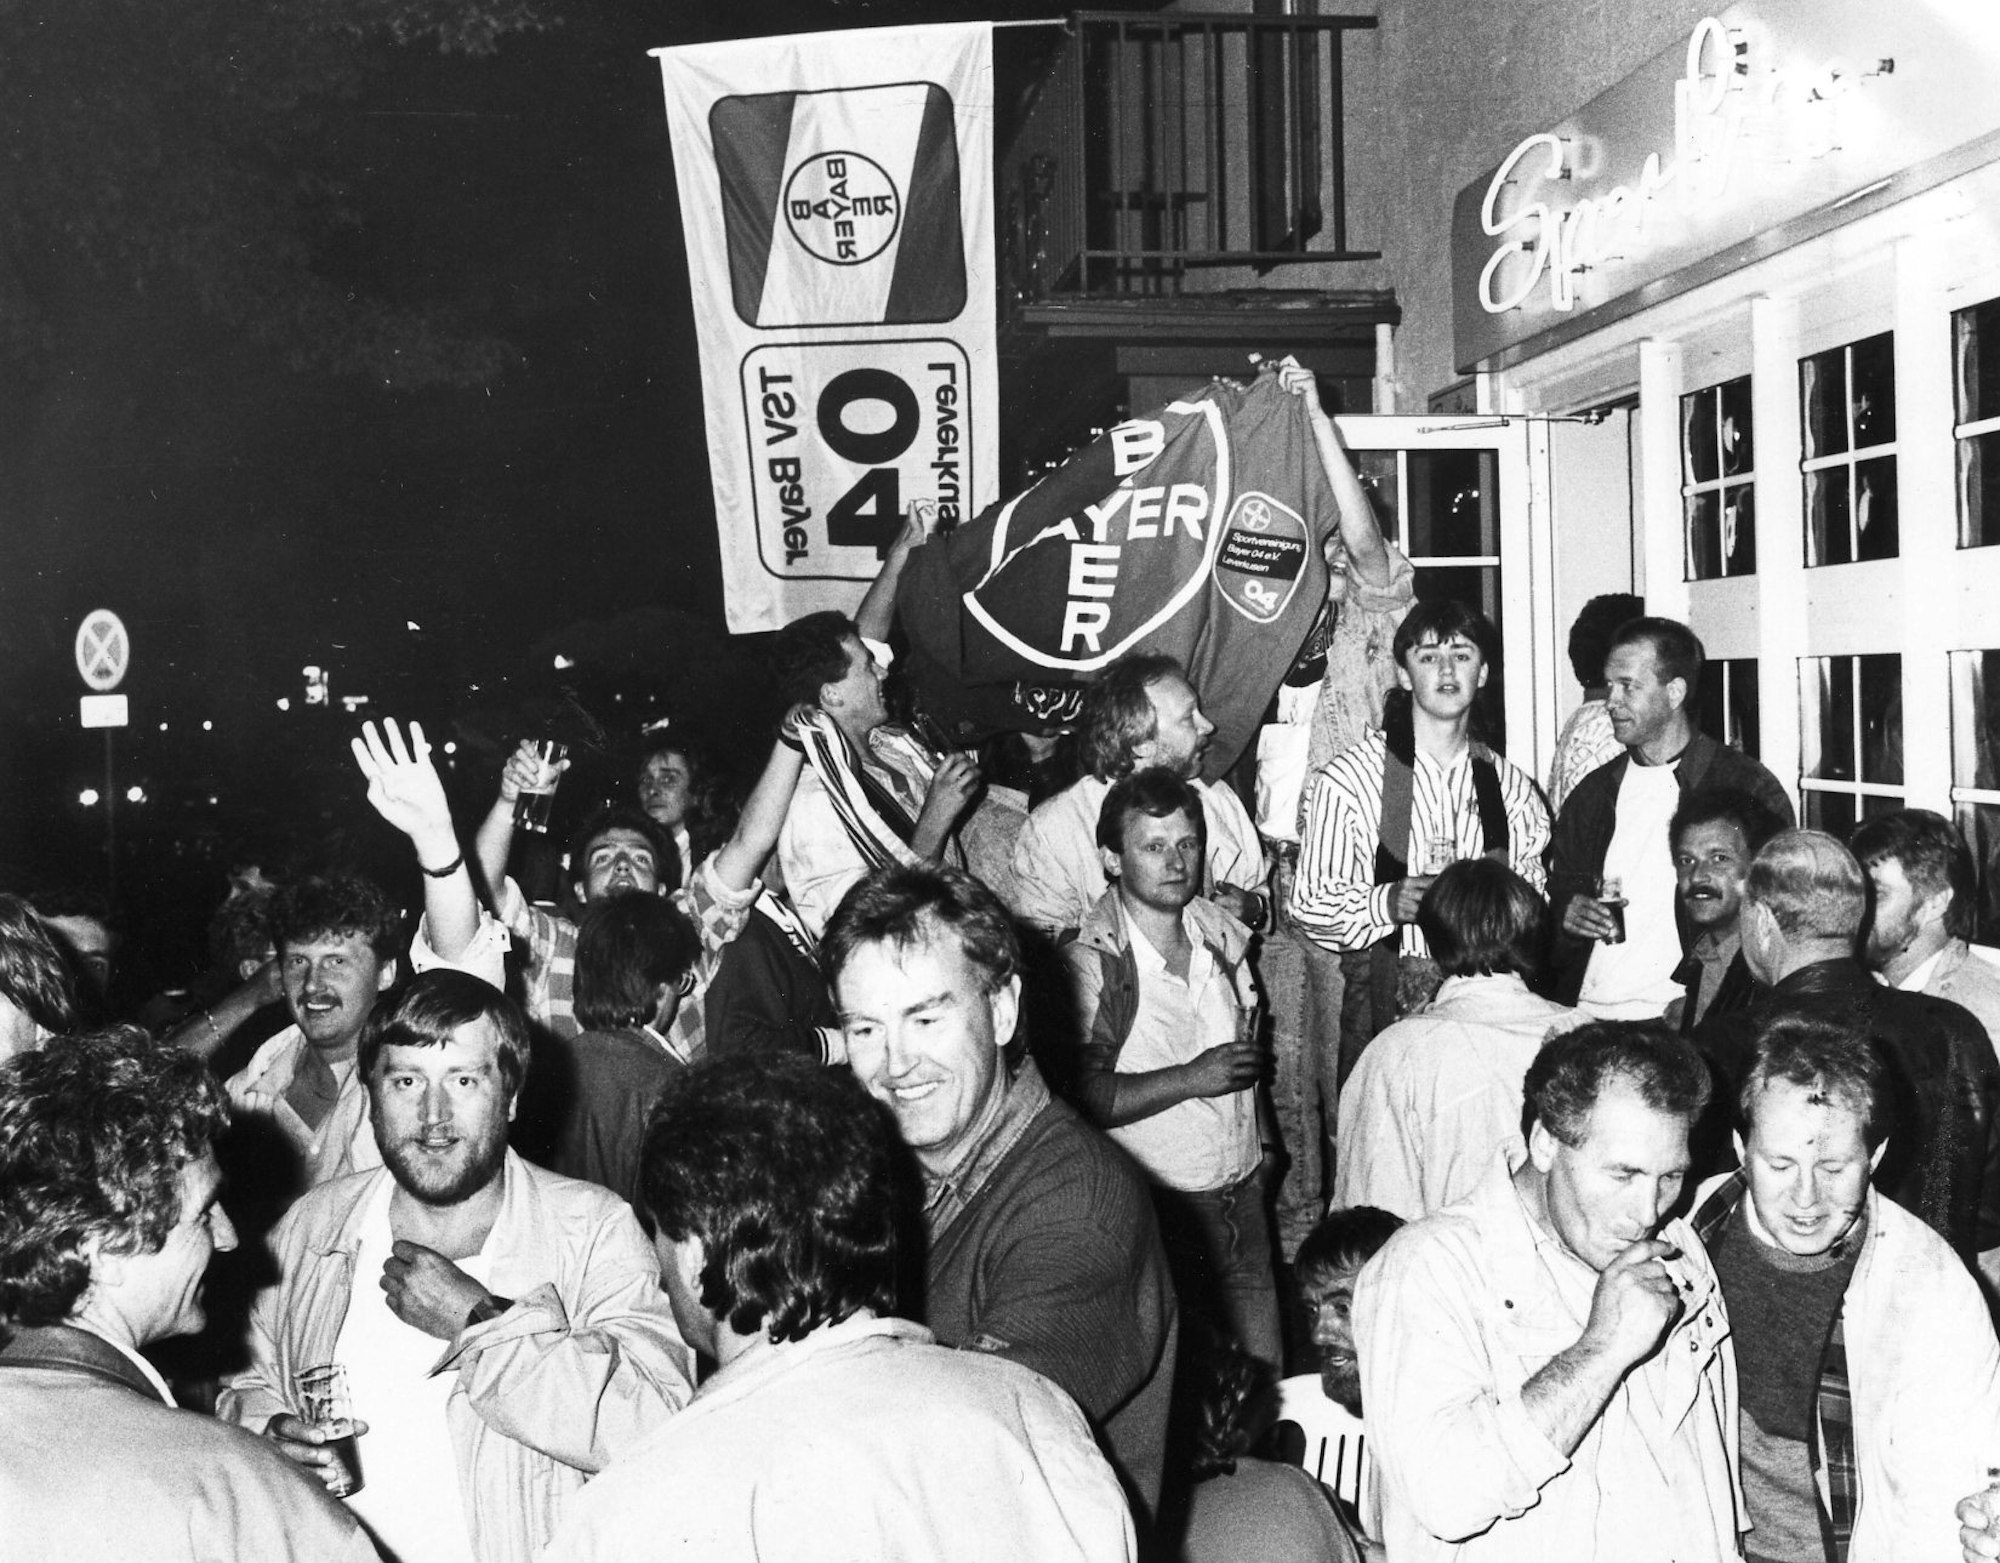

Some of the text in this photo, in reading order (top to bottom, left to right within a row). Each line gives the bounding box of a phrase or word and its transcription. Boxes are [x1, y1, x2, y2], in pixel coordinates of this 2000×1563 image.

[1227, 543, 1251, 556] Bayer
[1251, 549, 1265, 558] 04
[1222, 555, 1269, 572] Leverkusen
